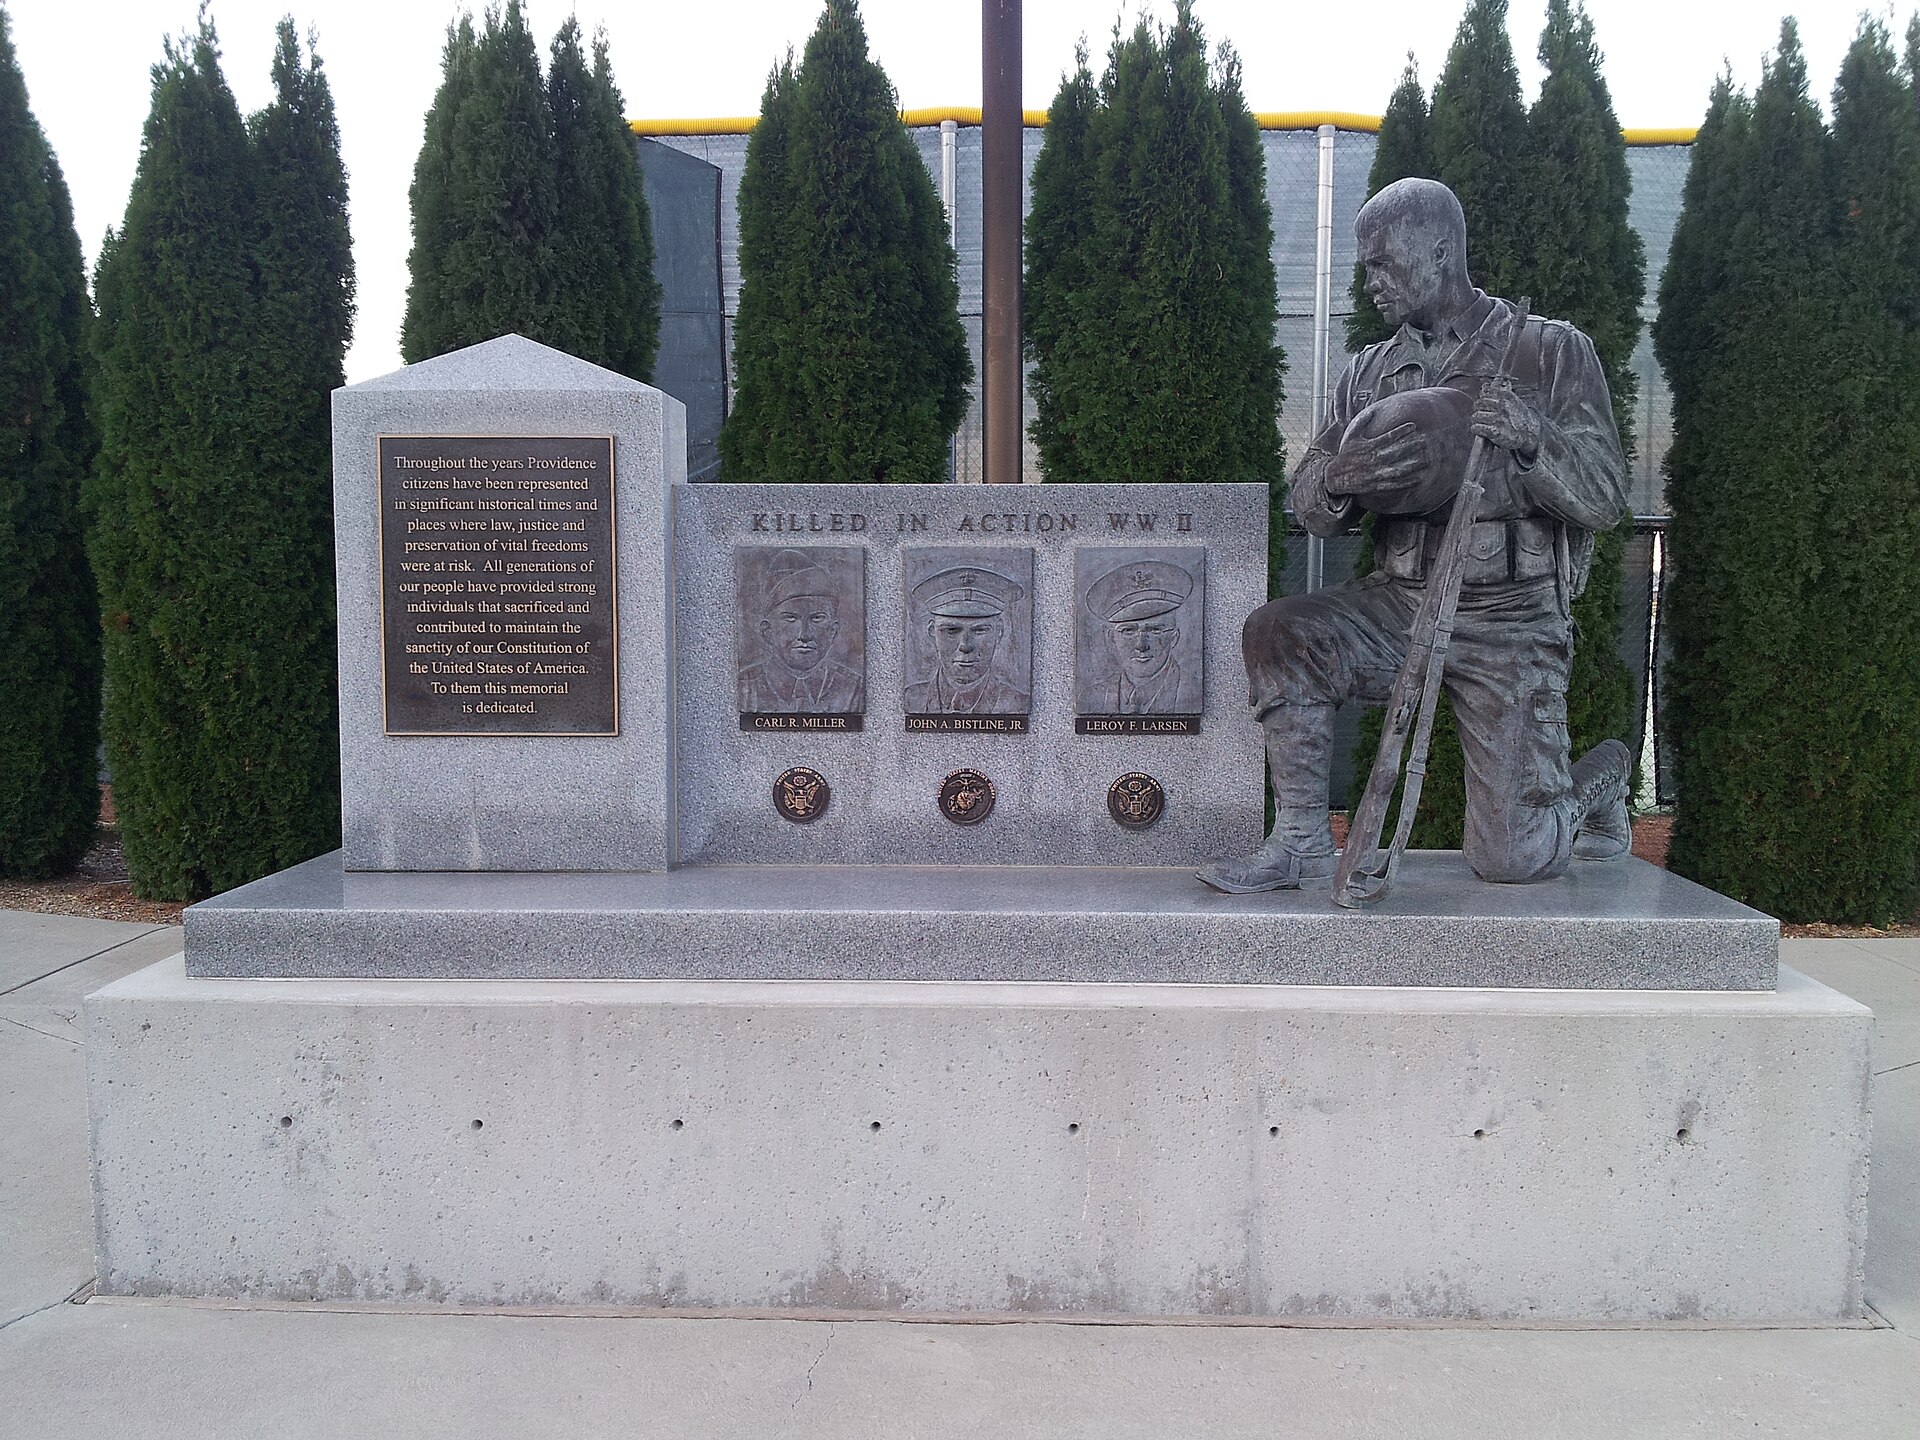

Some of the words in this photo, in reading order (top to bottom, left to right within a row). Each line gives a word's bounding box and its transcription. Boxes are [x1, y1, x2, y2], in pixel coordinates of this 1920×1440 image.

[394, 457, 465, 472] Throughout
[469, 457, 489, 468] the
[492, 459, 524, 472] years
[528, 457, 597, 468] Providence
[402, 477, 449, 489] citizens
[453, 477, 482, 489] have
[485, 477, 514, 489] been
[518, 477, 589, 493] represented
[395, 498, 406, 510] in
[410, 498, 475, 514] significant
[478, 498, 534, 510] historical
[538, 498, 572, 510] times
[575, 498, 598, 510] and
[407, 518, 446, 534] places
[449, 518, 487, 530] where
[490, 518, 515, 532] law,
[517, 518, 559, 534] justice
[562, 518, 585, 530] and
[752, 514, 867, 531] KILLED
[897, 514, 929, 531] IN
[958, 514, 1079, 531] ACTION
[1108, 514, 1156, 531] WW
[1177, 515, 1192, 531] II
[405, 539, 480, 555] preservation
[484, 539, 499, 551] of
[500, 539, 527, 551] vital
[531, 539, 589, 551] freedoms
[400, 563, 430, 572] were
[434, 561, 445, 572] at
[448, 559, 476, 572] risk.
[483, 559, 502, 572] All
[506, 559, 577, 576] generations
[580, 559, 595, 572] of
[399, 583, 420, 592] our
[423, 580, 464, 596] people
[467, 580, 497, 592] have
[500, 580, 554, 596] provided
[557, 580, 596, 596] strong
[407, 601, 474, 613] individuals
[478, 601, 501, 613] that
[504, 601, 564, 613] sacrificed
[567, 601, 590, 613] and
[416, 621, 485, 633] contributed
[489, 621, 501, 633] to
[505, 621, 558, 633] maintain
[561, 621, 581, 633] the
[406, 642, 453, 657] sanctity
[456, 642, 471, 653] of
[473, 644, 493, 653] our
[496, 642, 572, 653] Constitution
[575, 642, 591, 653] of
[409, 662, 428, 673] the
[431, 662, 473, 673] United
[476, 662, 513, 673] States
[516, 662, 531, 673] of
[533, 662, 589, 673] America.
[431, 682, 447, 693] To
[451, 682, 481, 693] them
[484, 682, 507, 693] this
[510, 682, 569, 693] memorial
[462, 702, 473, 713] is
[476, 702, 538, 713] dedicated.
[755, 718, 786, 728] CARL
[789, 718, 799, 728] R.
[802, 718, 846, 728] MILLER
[909, 719, 937, 729] JOHN
[940, 719, 951, 729] A.
[954, 719, 1007, 731] BISTLINE,
[1010, 720, 1024, 730] JR.
[1087, 721, 1125, 731] LEROY
[1129, 721, 1137, 731] F.
[1142, 721, 1188, 731] LARSEN
